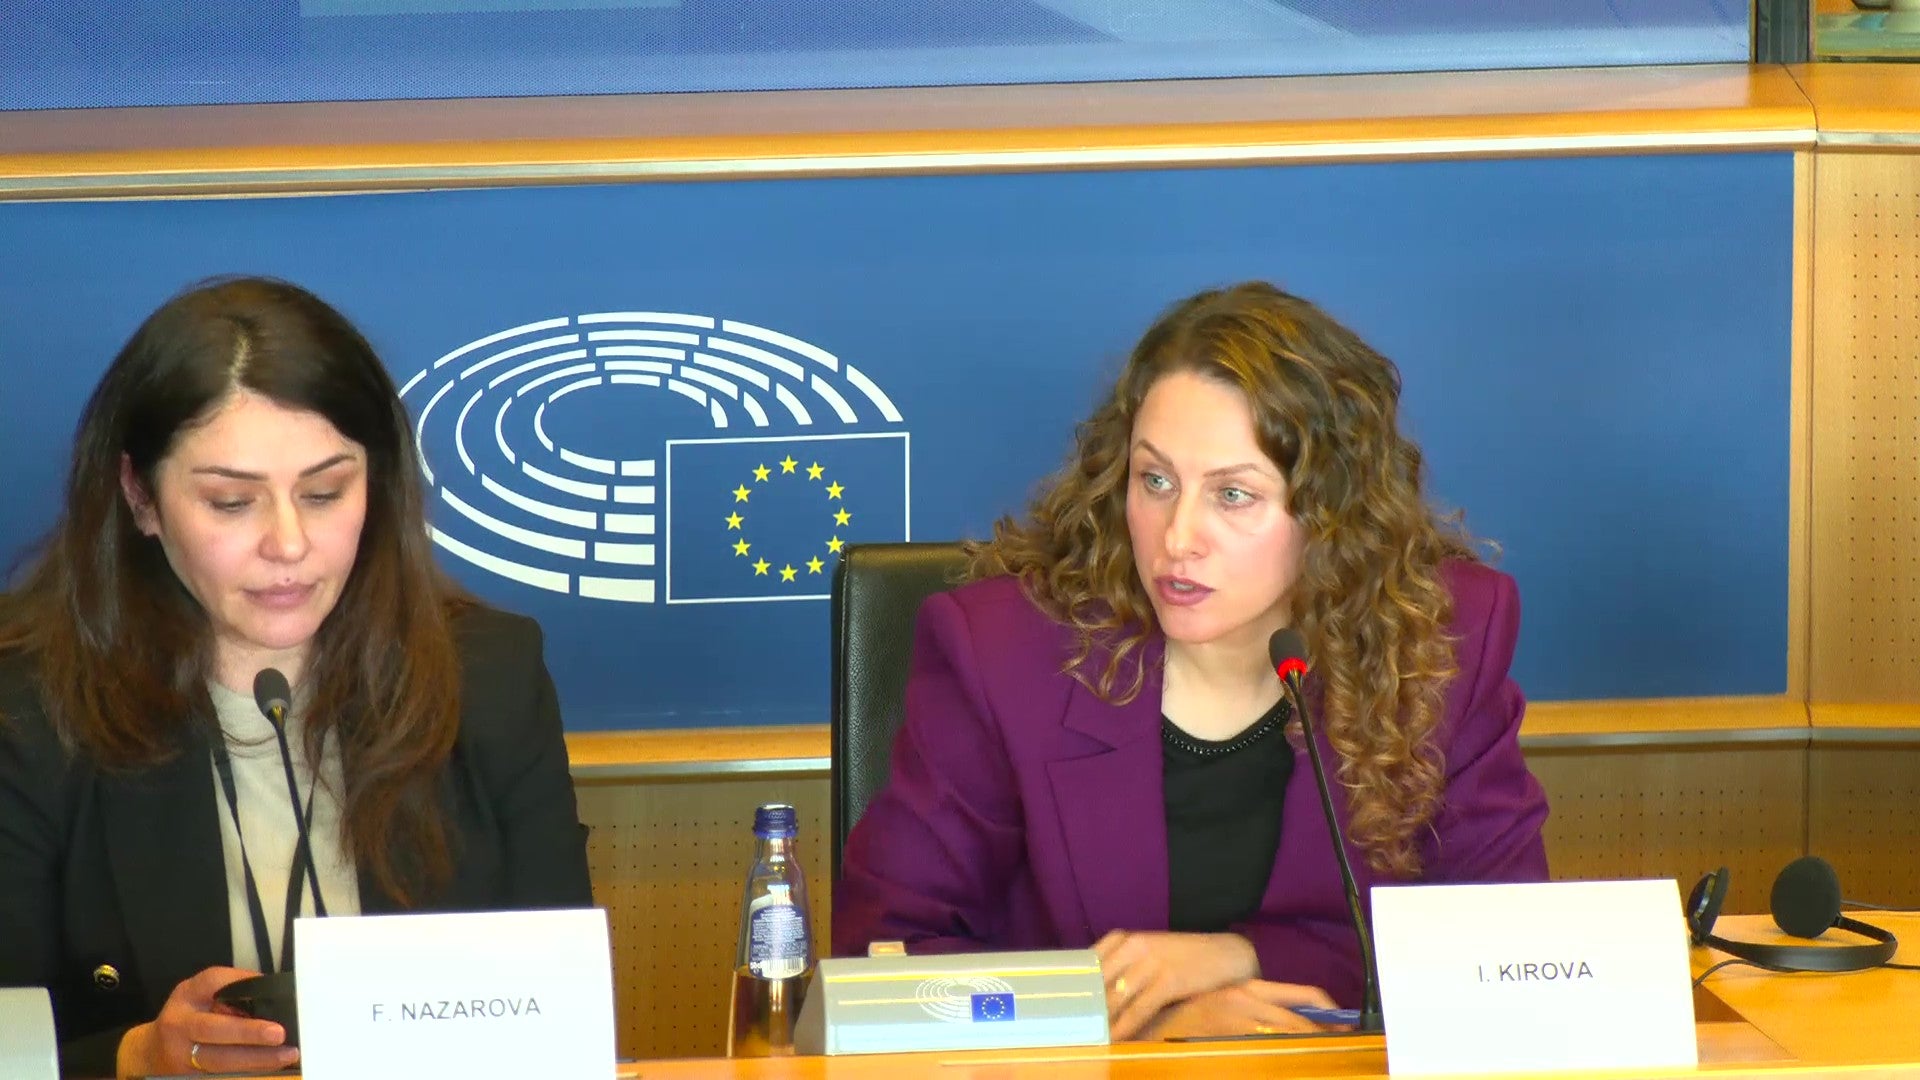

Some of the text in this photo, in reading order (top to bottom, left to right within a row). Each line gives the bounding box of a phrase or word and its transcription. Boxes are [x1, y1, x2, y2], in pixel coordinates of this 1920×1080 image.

[1478, 962, 1594, 982] I. KIROVA
[372, 998, 541, 1021] F. NAZAROVA
